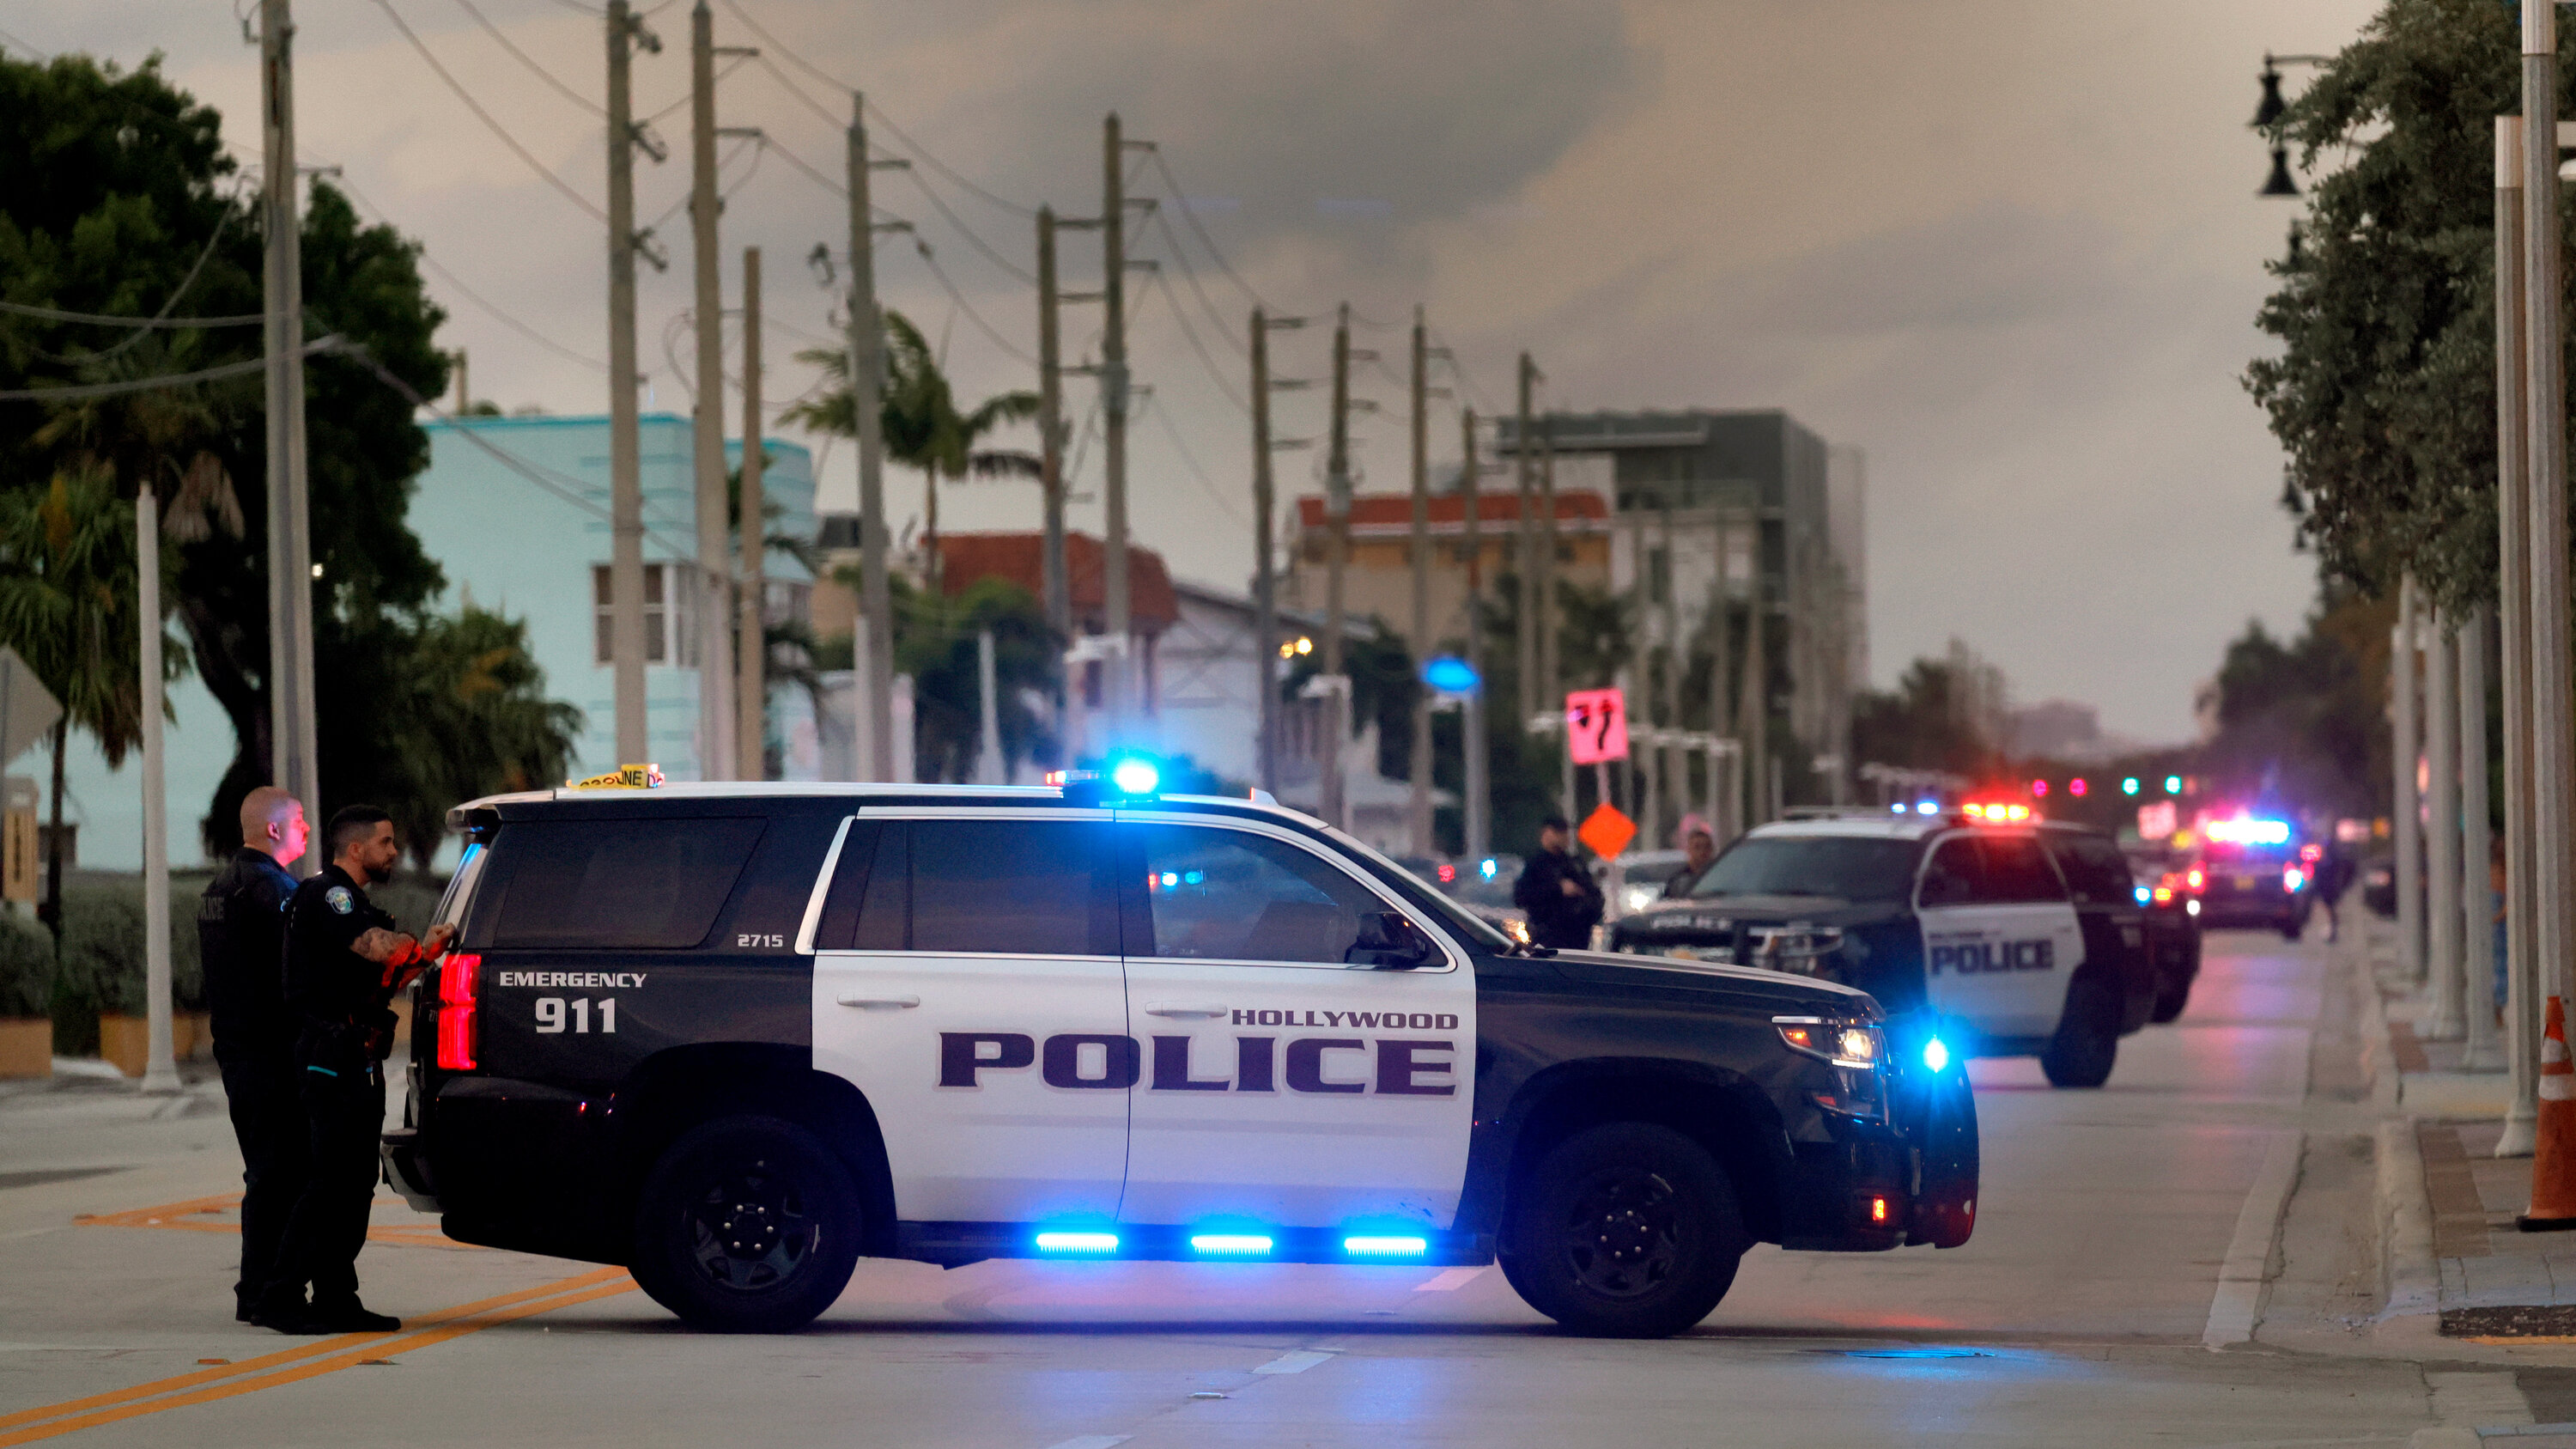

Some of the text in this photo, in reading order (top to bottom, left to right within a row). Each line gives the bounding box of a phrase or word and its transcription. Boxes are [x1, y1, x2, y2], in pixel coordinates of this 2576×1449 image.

[738, 934, 783, 947] 2715
[1931, 939, 2053, 976] POLICE
[499, 971, 647, 989] EMERGENCY
[535, 996, 617, 1034] 911
[1230, 1008, 1459, 1030] HOLLYWOOD
[937, 1031, 1457, 1096] POLICE
